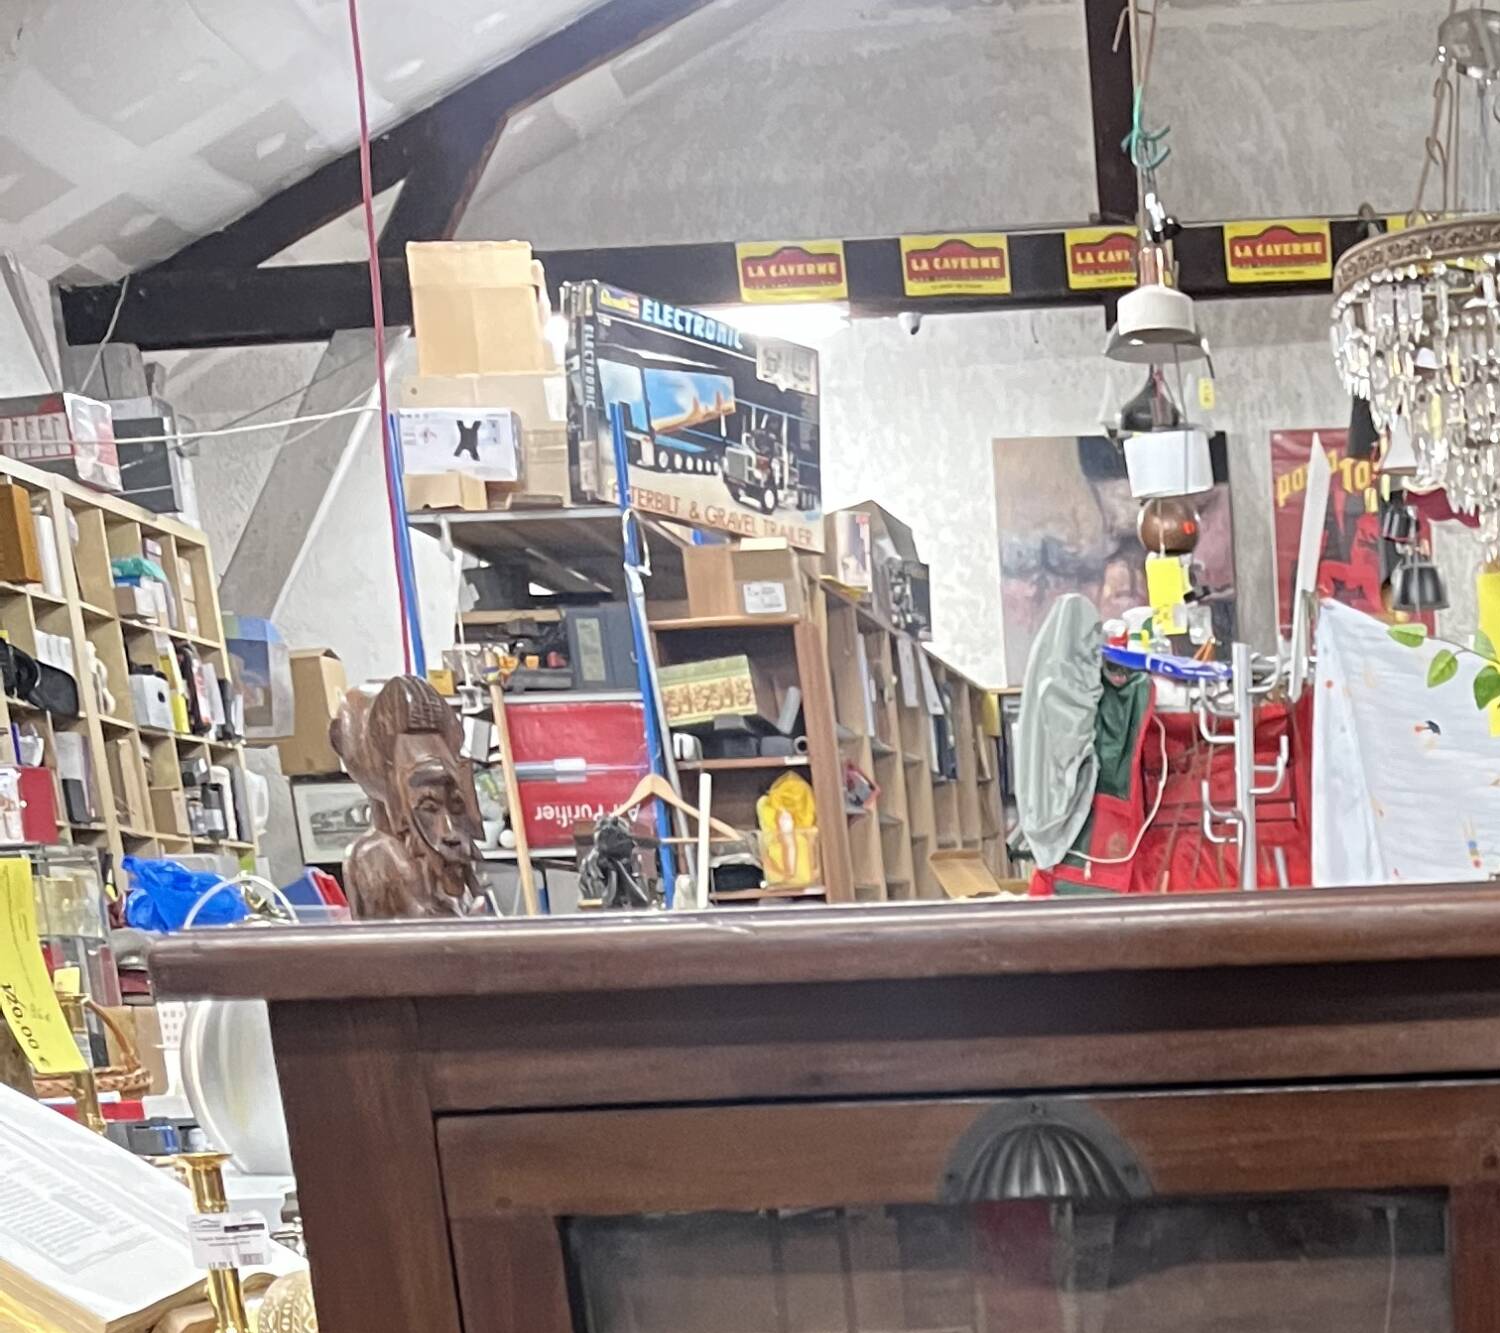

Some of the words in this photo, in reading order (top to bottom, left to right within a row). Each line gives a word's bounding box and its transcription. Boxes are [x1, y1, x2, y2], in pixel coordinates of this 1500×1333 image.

[1075, 251, 1096, 265] LA
[1234, 244, 1254, 258] LA
[1256, 241, 1322, 257] CAVERNE
[746, 265, 766, 278] LA
[768, 261, 837, 277] CAVERNE
[910, 258, 930, 272] LA
[932, 256, 1000, 270] CAVERNE
[641, 297, 744, 349] ELECTRONIC
[583, 323, 596, 410] ELECTRONIC
[688, 500, 700, 519] &
[704, 505, 758, 536] GRAVEL
[761, 519, 813, 547] TRAILER
